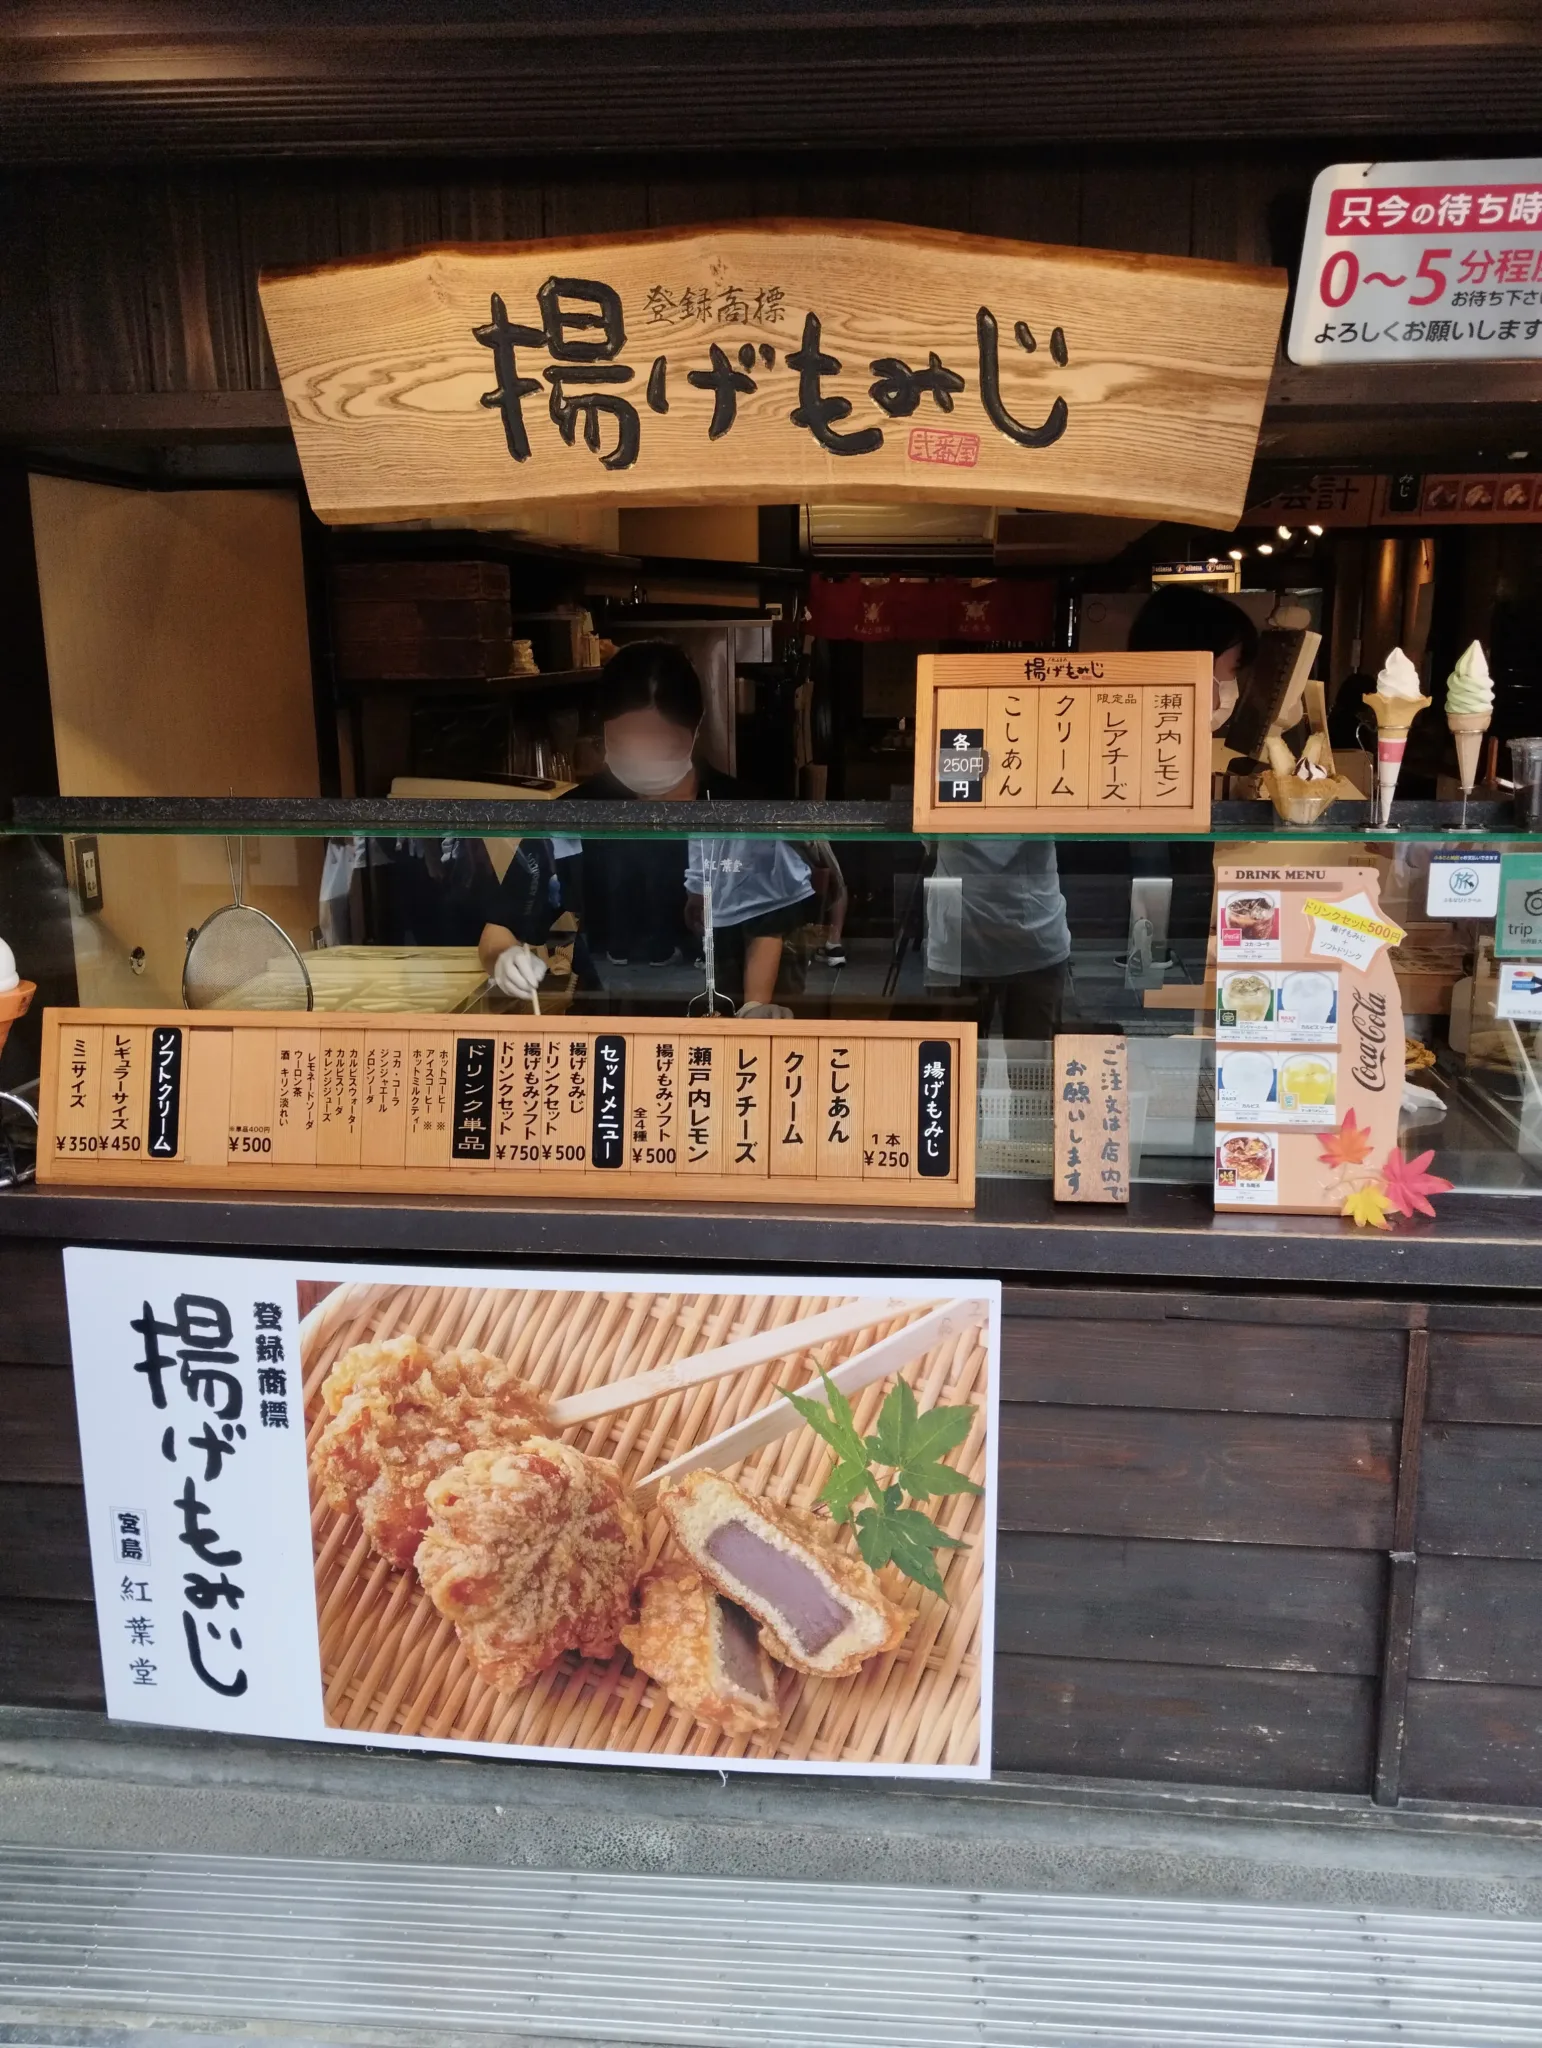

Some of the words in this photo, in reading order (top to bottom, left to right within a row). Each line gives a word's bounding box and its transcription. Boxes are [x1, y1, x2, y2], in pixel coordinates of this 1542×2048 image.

[1338, 191, 1542, 229] 只今の待ち時
[642, 284, 786, 325] 登録商標
[1314, 318, 1542, 344] よろしくお願いします
[1451, 289, 1542, 307] お待ち下さ
[472, 275, 1069, 470] 揚げもみじ
[1024, 657, 1104, 681] 揚げもみじ
[1097, 693, 1137, 704] 限定品
[943, 757, 984, 774] 250円
[953, 733, 971, 752] 各
[1000, 696, 1022, 796] こしあん
[1051, 695, 1075, 796] クリーム
[1102, 712, 1129, 801] レアチーズ
[1154, 693, 1183, 798] 瀬戸内レモン
[953, 781, 969, 798] 円
[1235, 869, 1281, 880] DRINK
[1285, 870, 1326, 880] MENU
[1303, 901, 1401, 943] ドリンクセット500円
[1320, 941, 1362, 960] ソフトドリンク
[280, 1050, 290, 1061] 酒
[1351, 987, 1387, 1092] Coca-Cola
[70, 1039, 87, 1108] ミニサイズ
[111, 1034, 131, 1130] レギュラーサイズ
[154, 1034, 175, 1151] ソフトクリーム
[279, 1068, 290, 1127] キリン淡れい
[293, 1050, 303, 1097] ウーロン茶
[305, 1053, 316, 1130] レモネードソーダ
[322, 1048, 333, 1122] オレンジジュース
[335, 1049, 345, 1116] カルピスソーダ
[348, 1049, 358, 1134] カルピスウォーター
[366, 1050, 375, 1104] メロンソーダ
[379, 1049, 389, 1113] ジンジャエール
[392, 1051, 401, 1106] コカ・コーラ
[411, 1050, 422, 1133] ホットミルクティー
[424, 1049, 435, 1113] アイスコーヒー
[438, 1050, 449, 1113] ホットコーヒー
[458, 1044, 487, 1150] ドリンク単品
[498, 1041, 515, 1135] ドリンクセット
[522, 1042, 542, 1140] 揚げもみソフト
[544, 1041, 561, 1135] ドリンクセット
[568, 1042, 588, 1113] 揚げもみじ
[598, 1045, 620, 1159] セットメニュー
[655, 1043, 674, 1142] 揚げもみソフト
[688, 1046, 712, 1163] 瀬戸内レモン
[735, 1048, 758, 1164] レアチーズ
[782, 1051, 804, 1144] クリーム
[828, 1048, 850, 1144] こしあん
[633, 1108, 648, 1143] 全4種
[871, 1134, 901, 1147] 1本
[923, 1062, 946, 1157] 揚げもみじ
[1063, 1059, 1091, 1195] お願いします
[1101, 1043, 1127, 1200] ご注文は店内で
[56, 1136, 98, 1152] ¥350
[99, 1136, 141, 1151] ¥450
[229, 1137, 272, 1153] ¥500
[496, 1145, 539, 1161] ¥750
[542, 1145, 585, 1161] ¥500
[632, 1147, 676, 1164] ¥500
[864, 1150, 909, 1168] ¥250
[253, 1301, 289, 1430] 登録商標
[130, 1293, 248, 1697] 揚げもみじ
[118, 1511, 142, 1561] 宮島
[120, 1574, 157, 1686] 紅葉堂
